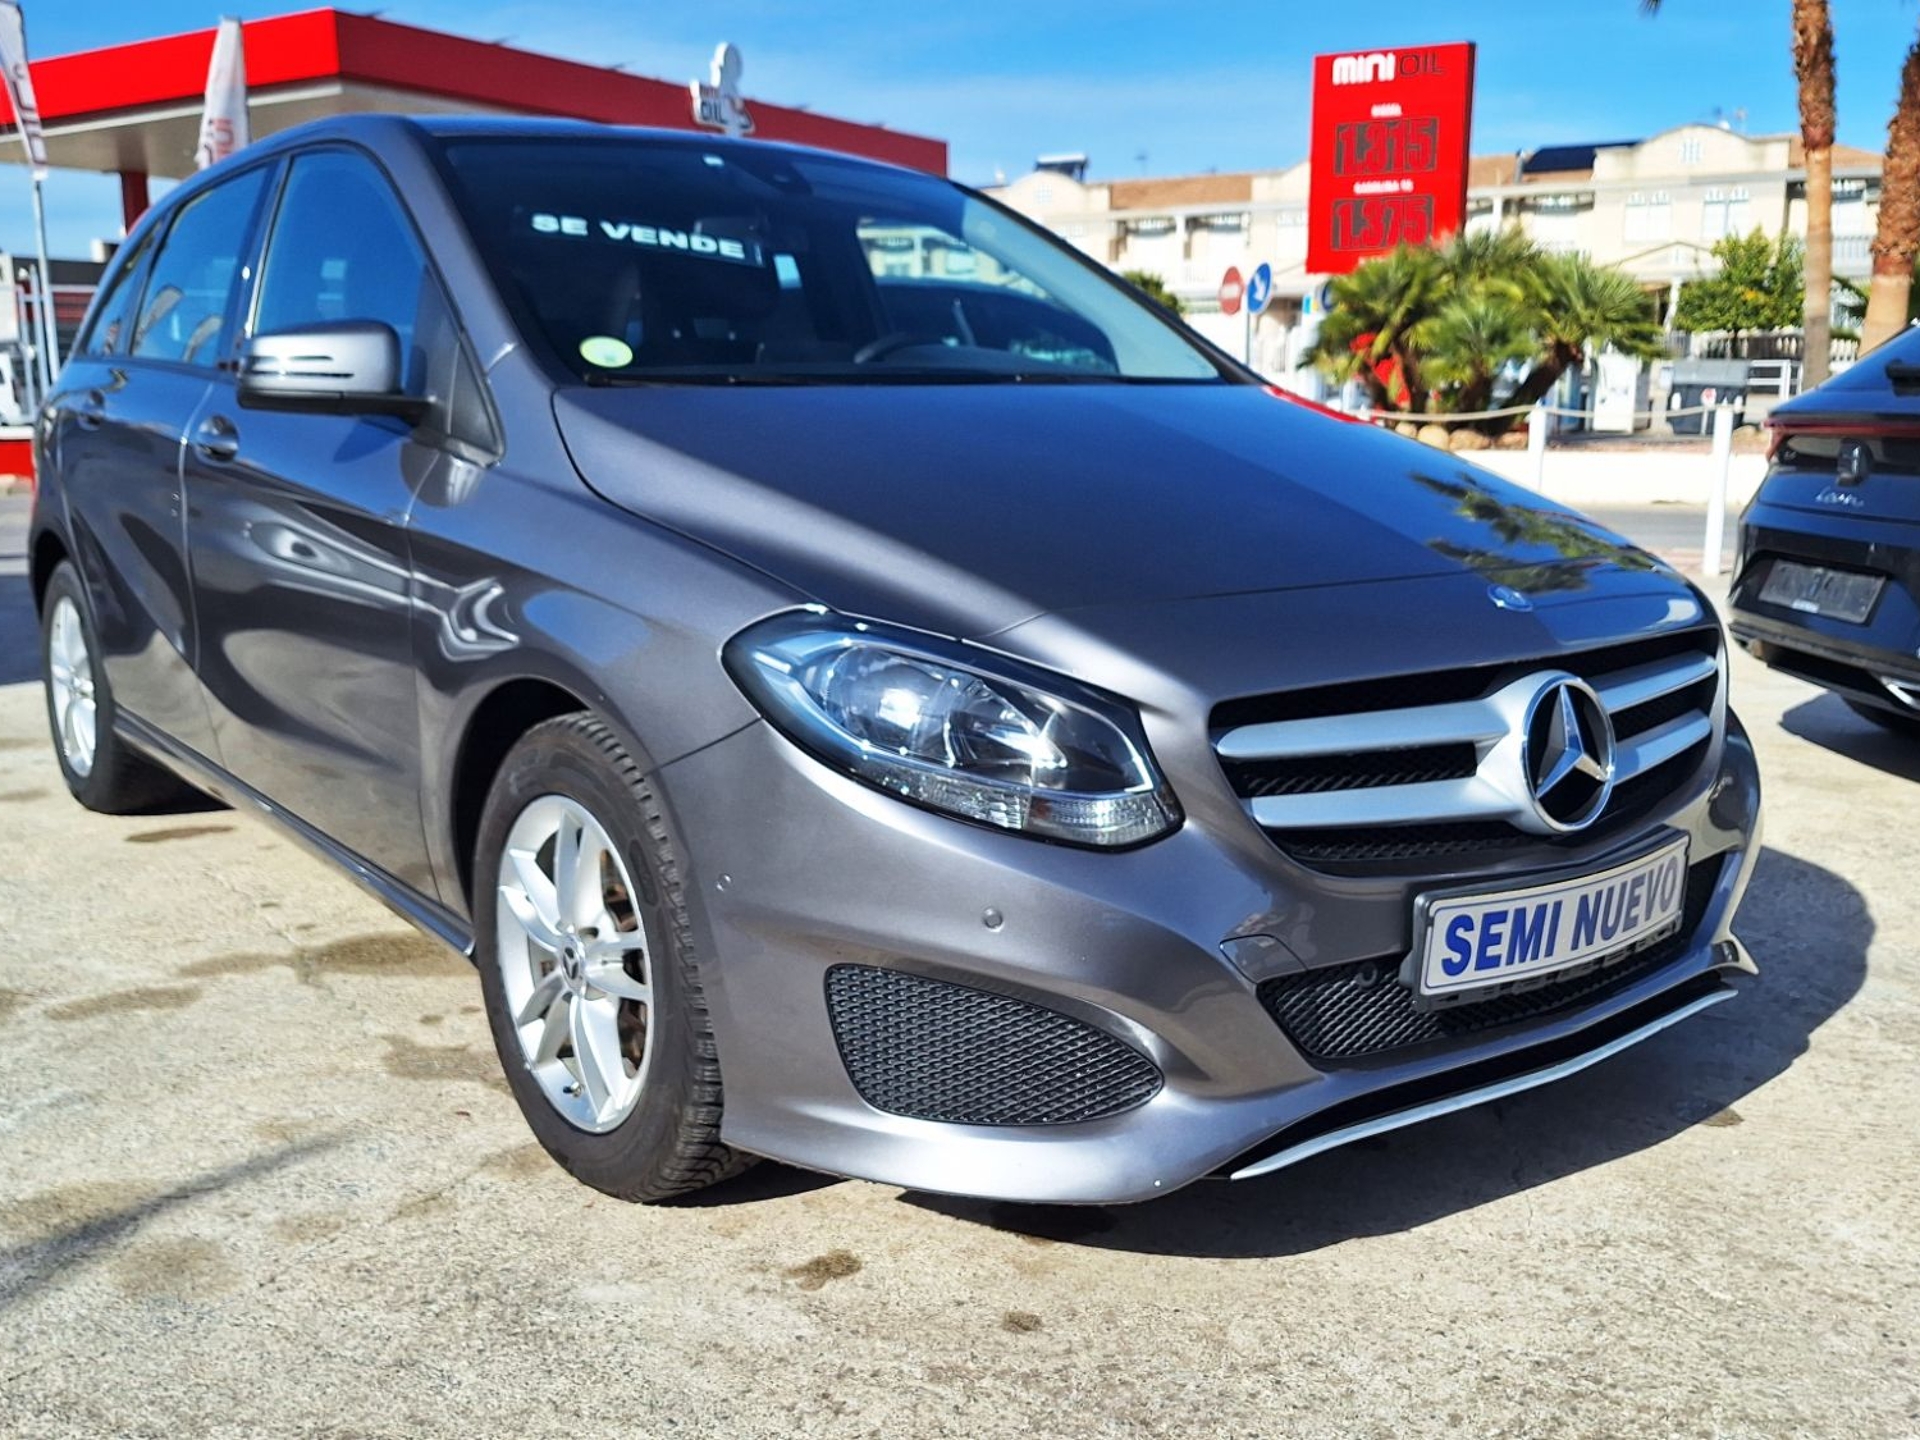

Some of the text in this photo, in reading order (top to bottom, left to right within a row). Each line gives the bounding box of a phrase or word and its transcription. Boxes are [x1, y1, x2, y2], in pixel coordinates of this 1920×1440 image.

[1400, 52, 1446, 77] OIL
[531, 213, 746, 260] SE VENDE
[1440, 855, 1679, 977] SEMI NUEVO
